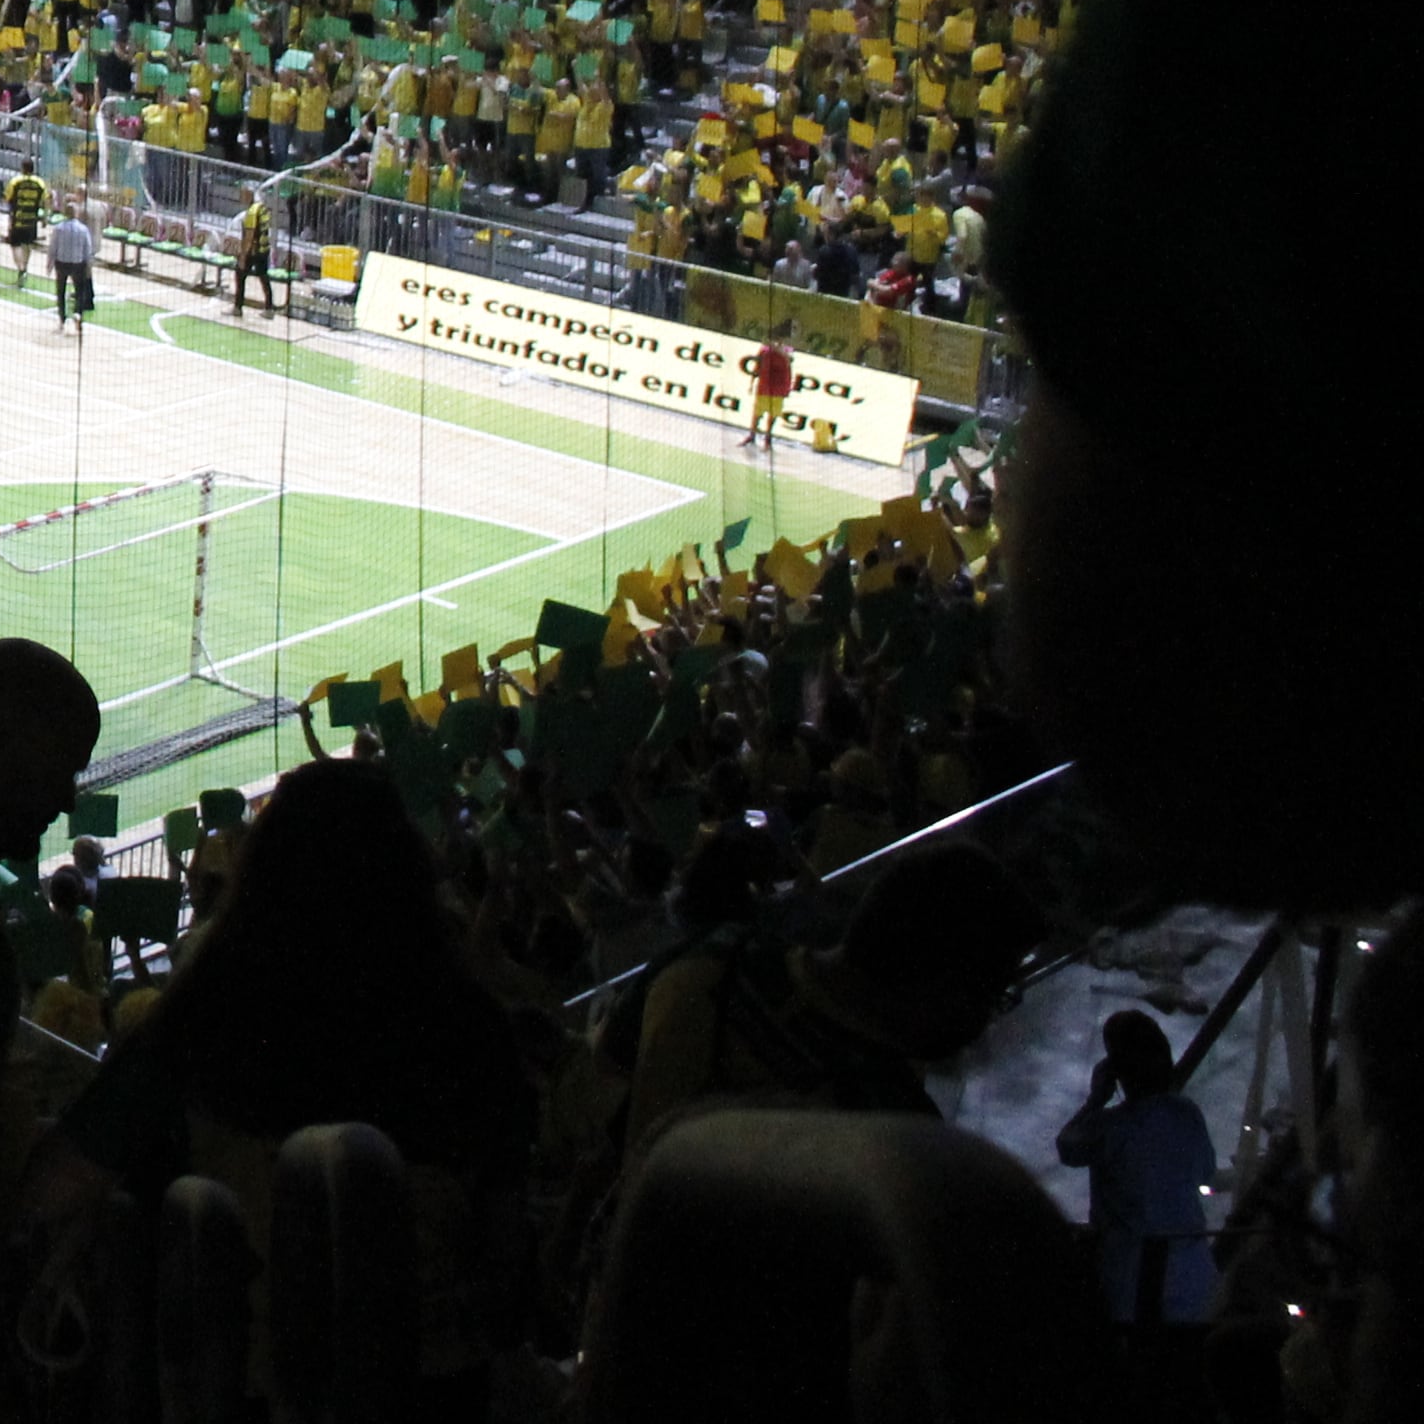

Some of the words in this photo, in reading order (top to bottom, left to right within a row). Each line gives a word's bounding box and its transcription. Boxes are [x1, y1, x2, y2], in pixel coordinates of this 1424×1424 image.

[397, 311, 418, 331] y
[428, 316, 629, 382] triunfador
[642, 371, 690, 399] en
[700, 383, 741, 412] la
[401, 277, 471, 307] eres
[483, 295, 660, 354] campeón
[674, 339, 725, 368] de
[739, 353, 865, 405] Cpa,
